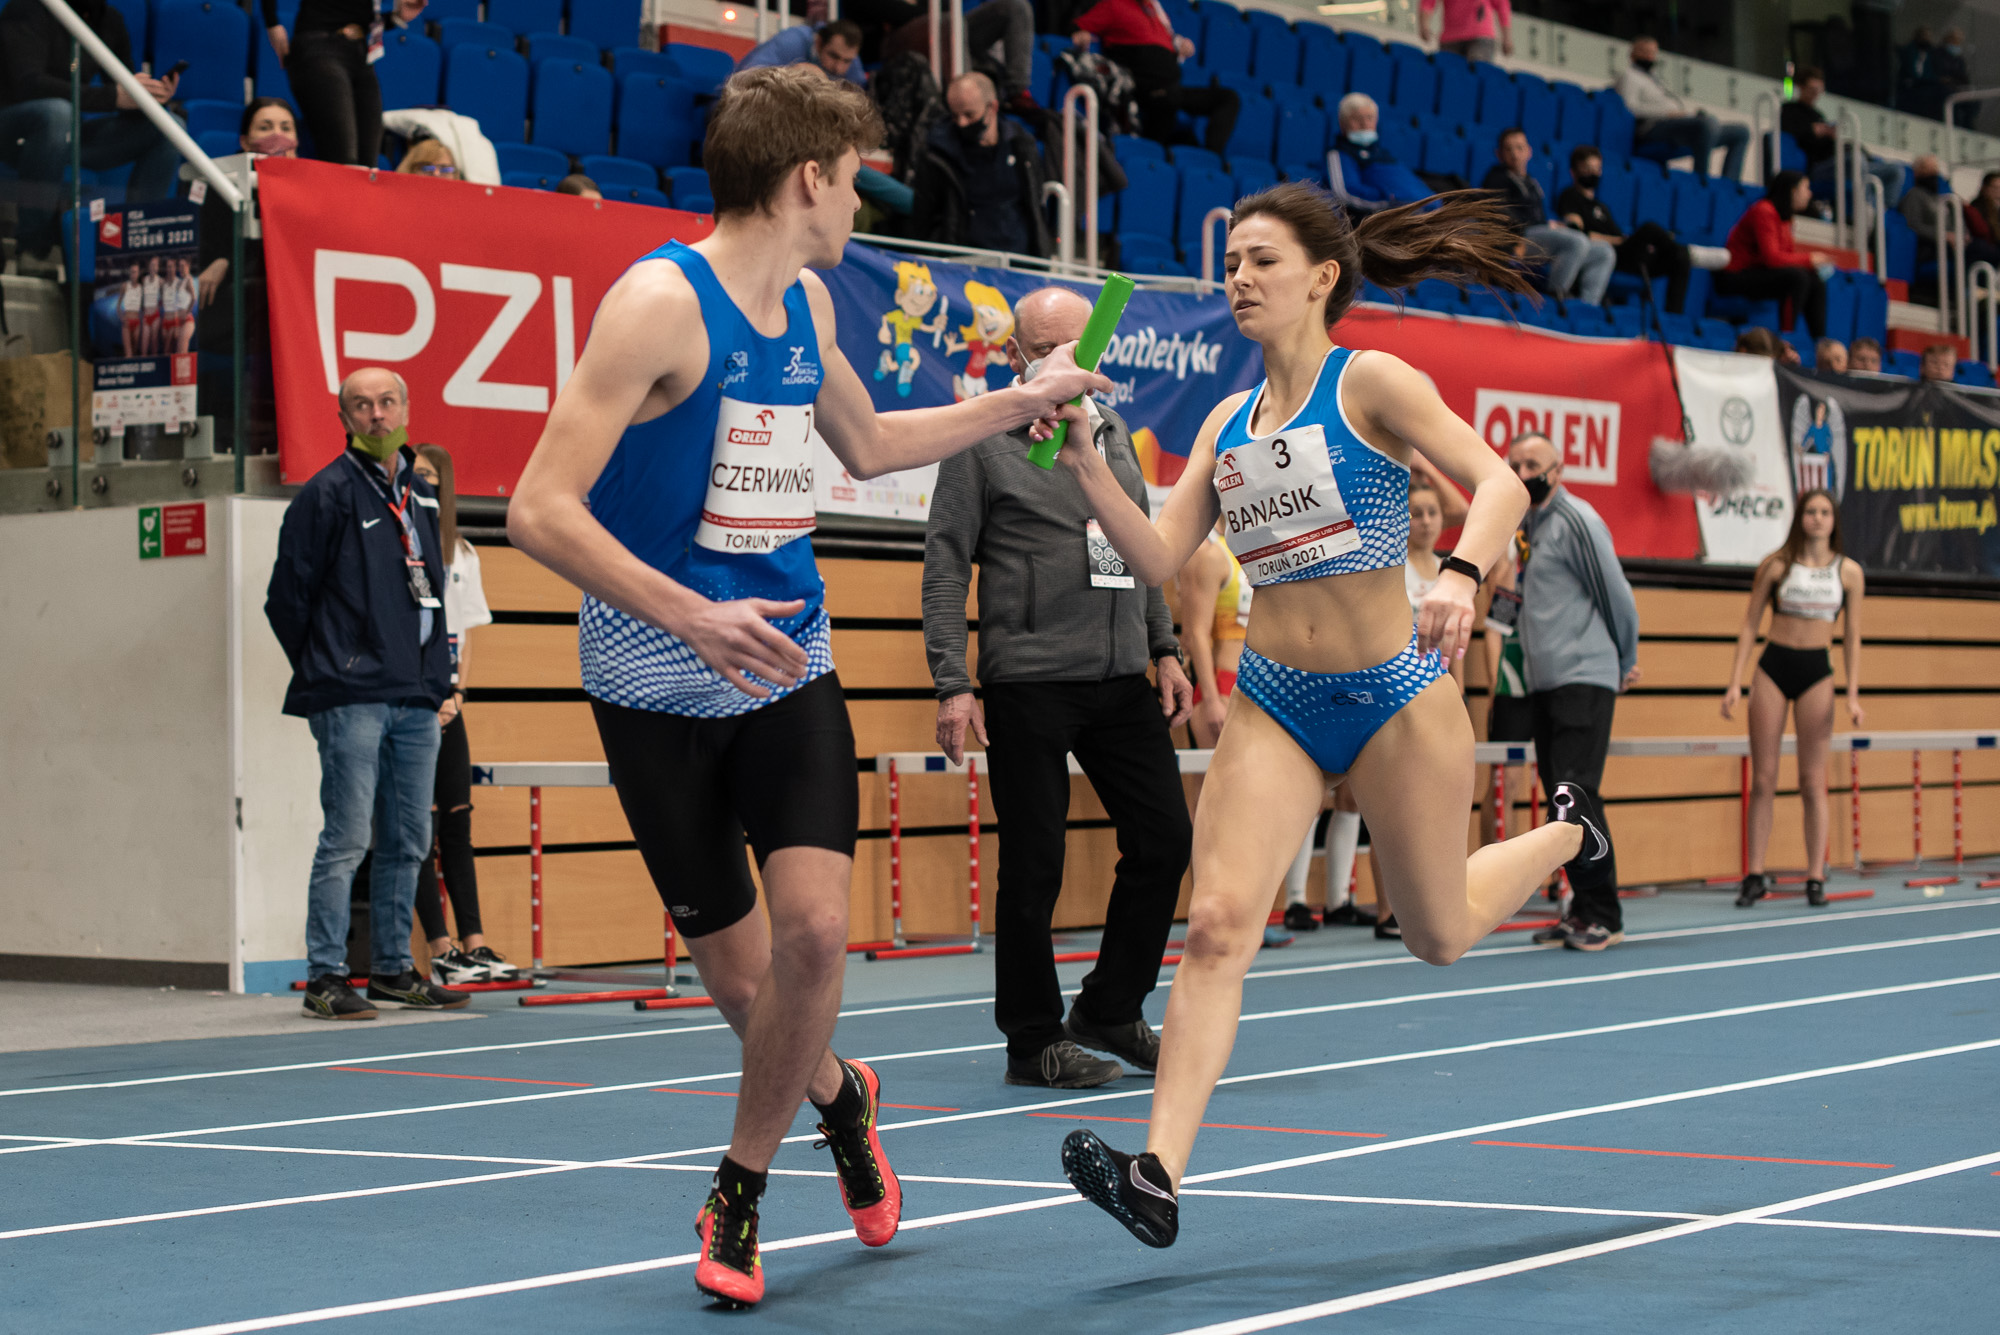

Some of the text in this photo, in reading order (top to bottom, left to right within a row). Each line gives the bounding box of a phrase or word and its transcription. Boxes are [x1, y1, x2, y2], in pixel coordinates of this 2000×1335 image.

[729, 430, 771, 445] ORLEN
[1271, 438, 1291, 469] 3
[1853, 411, 2000, 491] TORUŃ MIAS
[1227, 484, 1321, 533] BANASIK
[726, 530, 770, 548] TORUŃ
[1258, 544, 1326, 577] TORUŃ 2021
